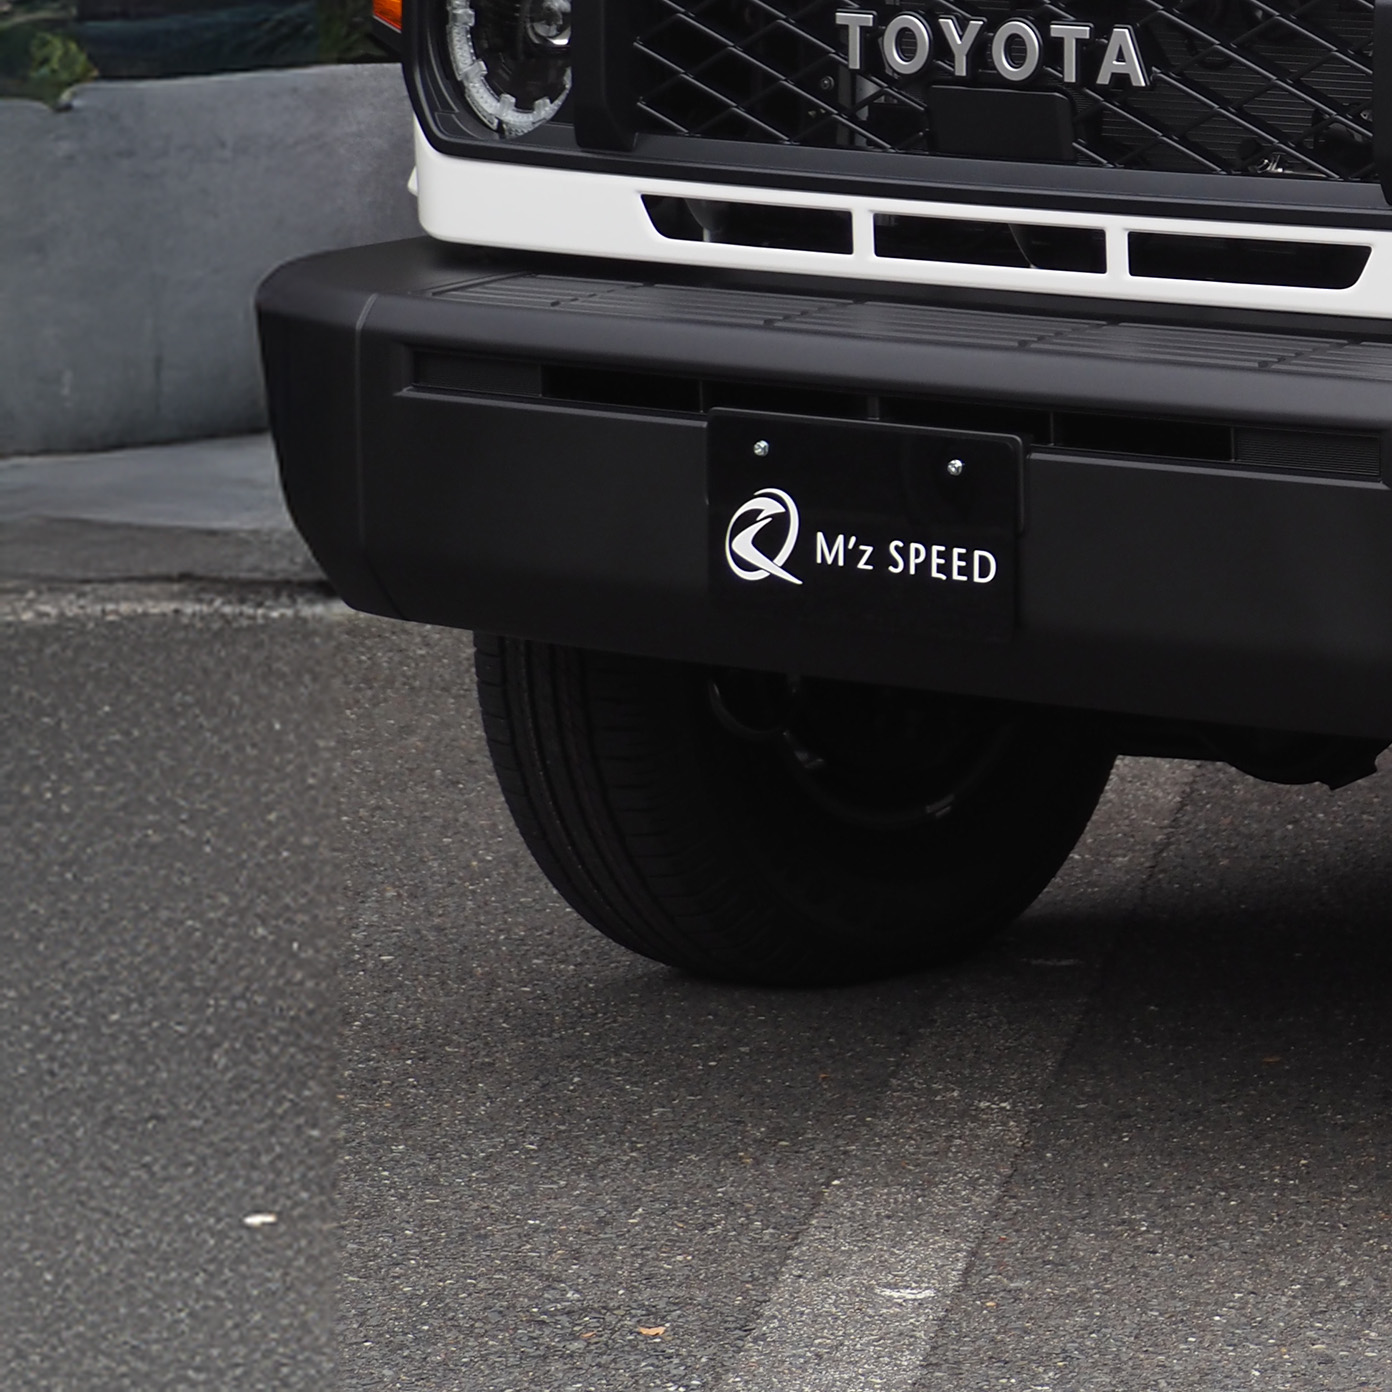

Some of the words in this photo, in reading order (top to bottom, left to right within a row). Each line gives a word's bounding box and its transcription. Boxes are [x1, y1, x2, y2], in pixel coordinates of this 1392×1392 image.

[833, 9, 1152, 90] TOYOTA
[815, 531, 874, 571] M'z
[888, 539, 998, 584] SPEED
